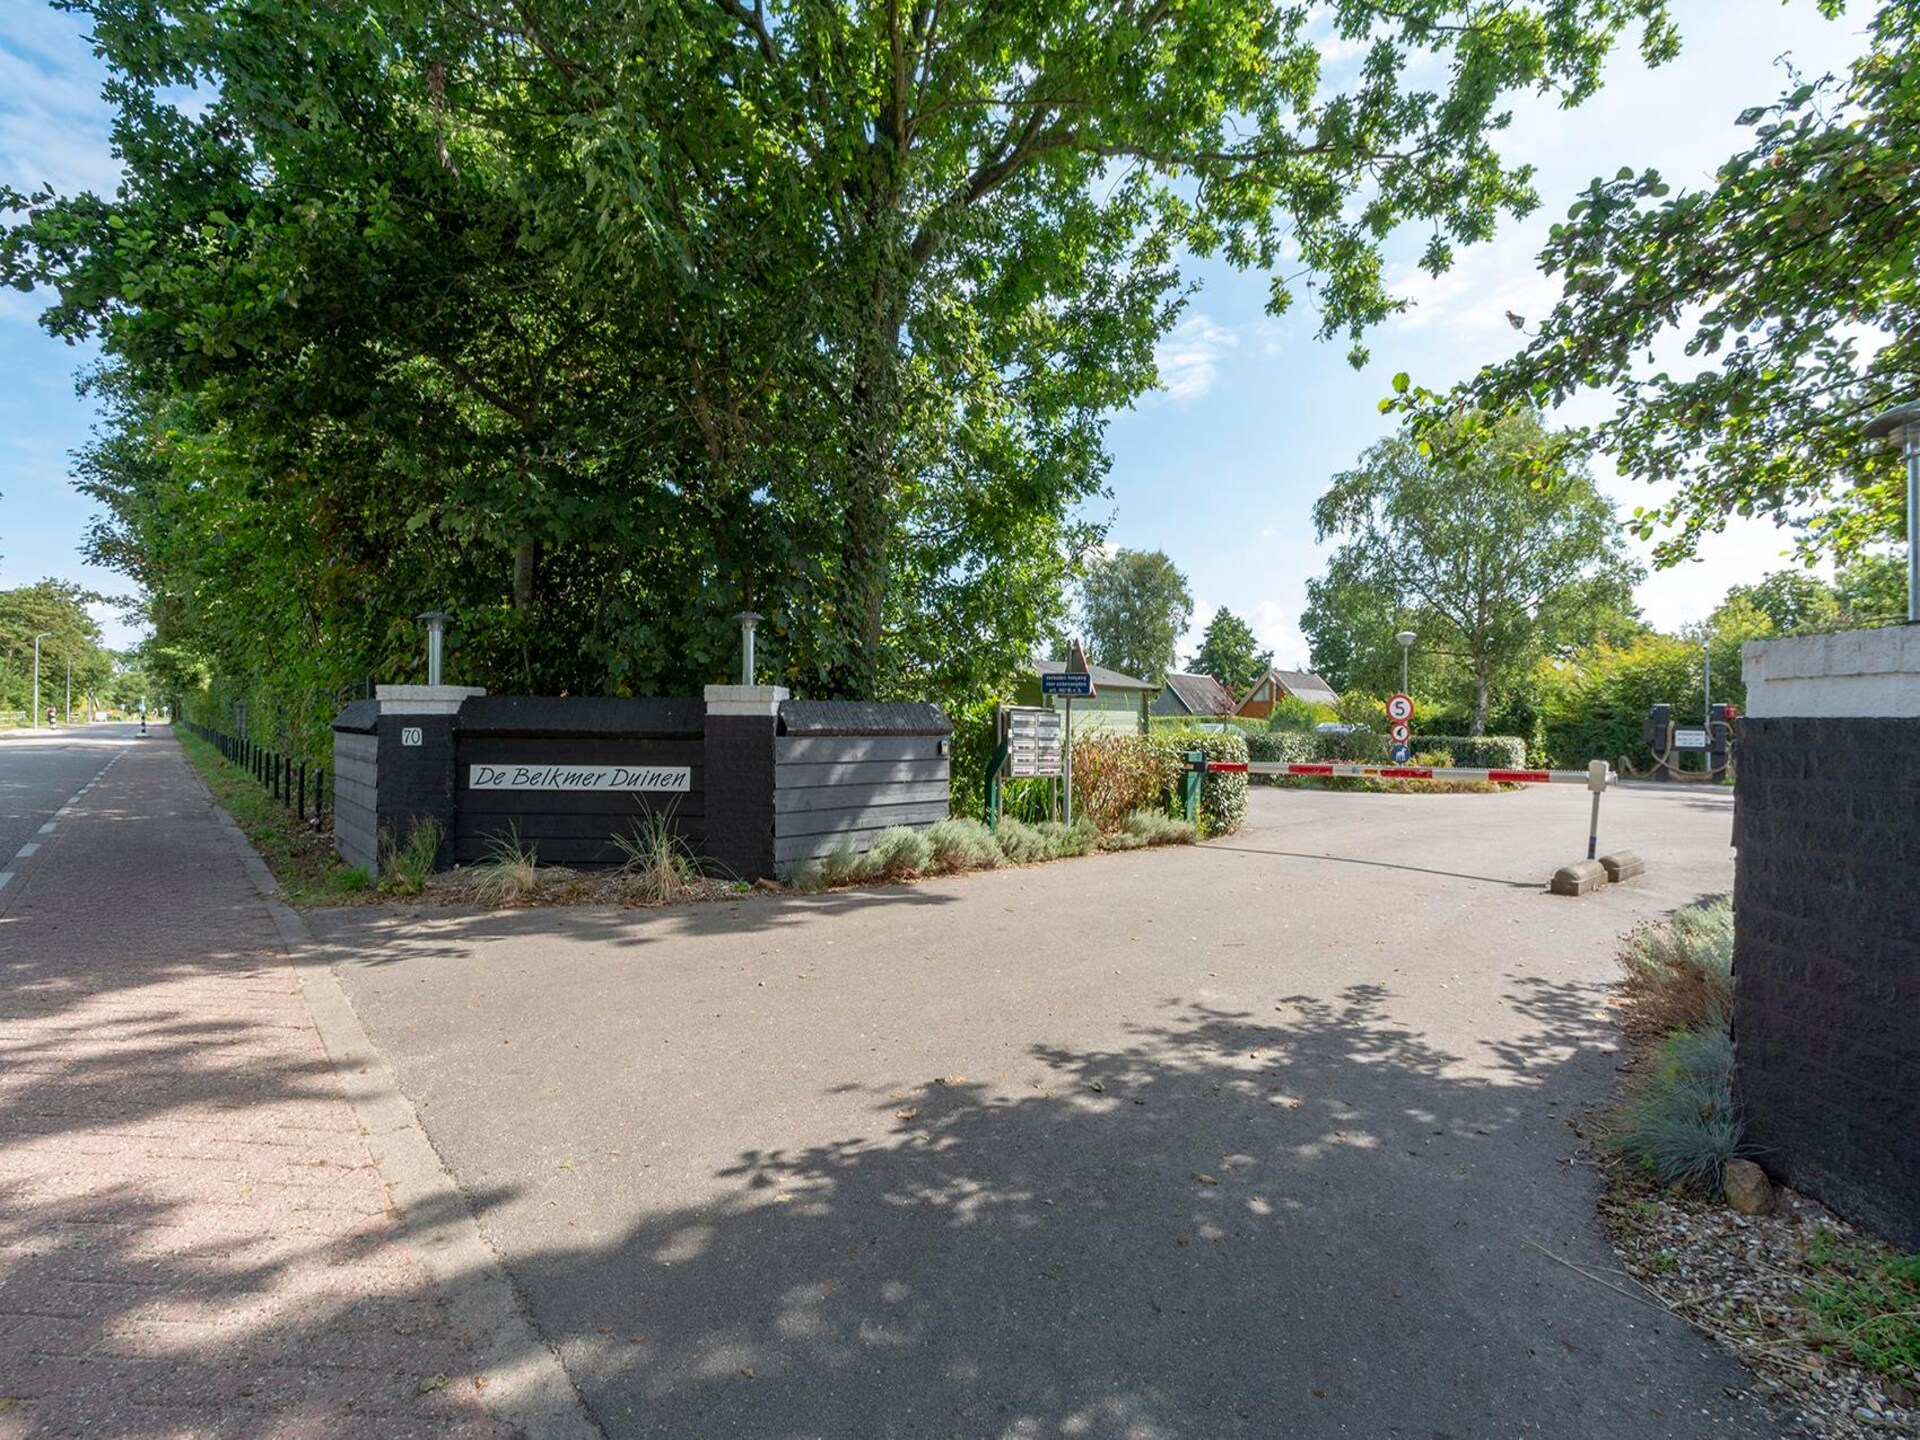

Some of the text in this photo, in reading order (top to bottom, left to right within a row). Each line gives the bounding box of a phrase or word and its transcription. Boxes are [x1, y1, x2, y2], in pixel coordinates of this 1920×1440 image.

[1395, 701, 1405, 716] 5
[403, 730, 420, 744] 70
[473, 767, 686, 788] De Belkmer Duinen
